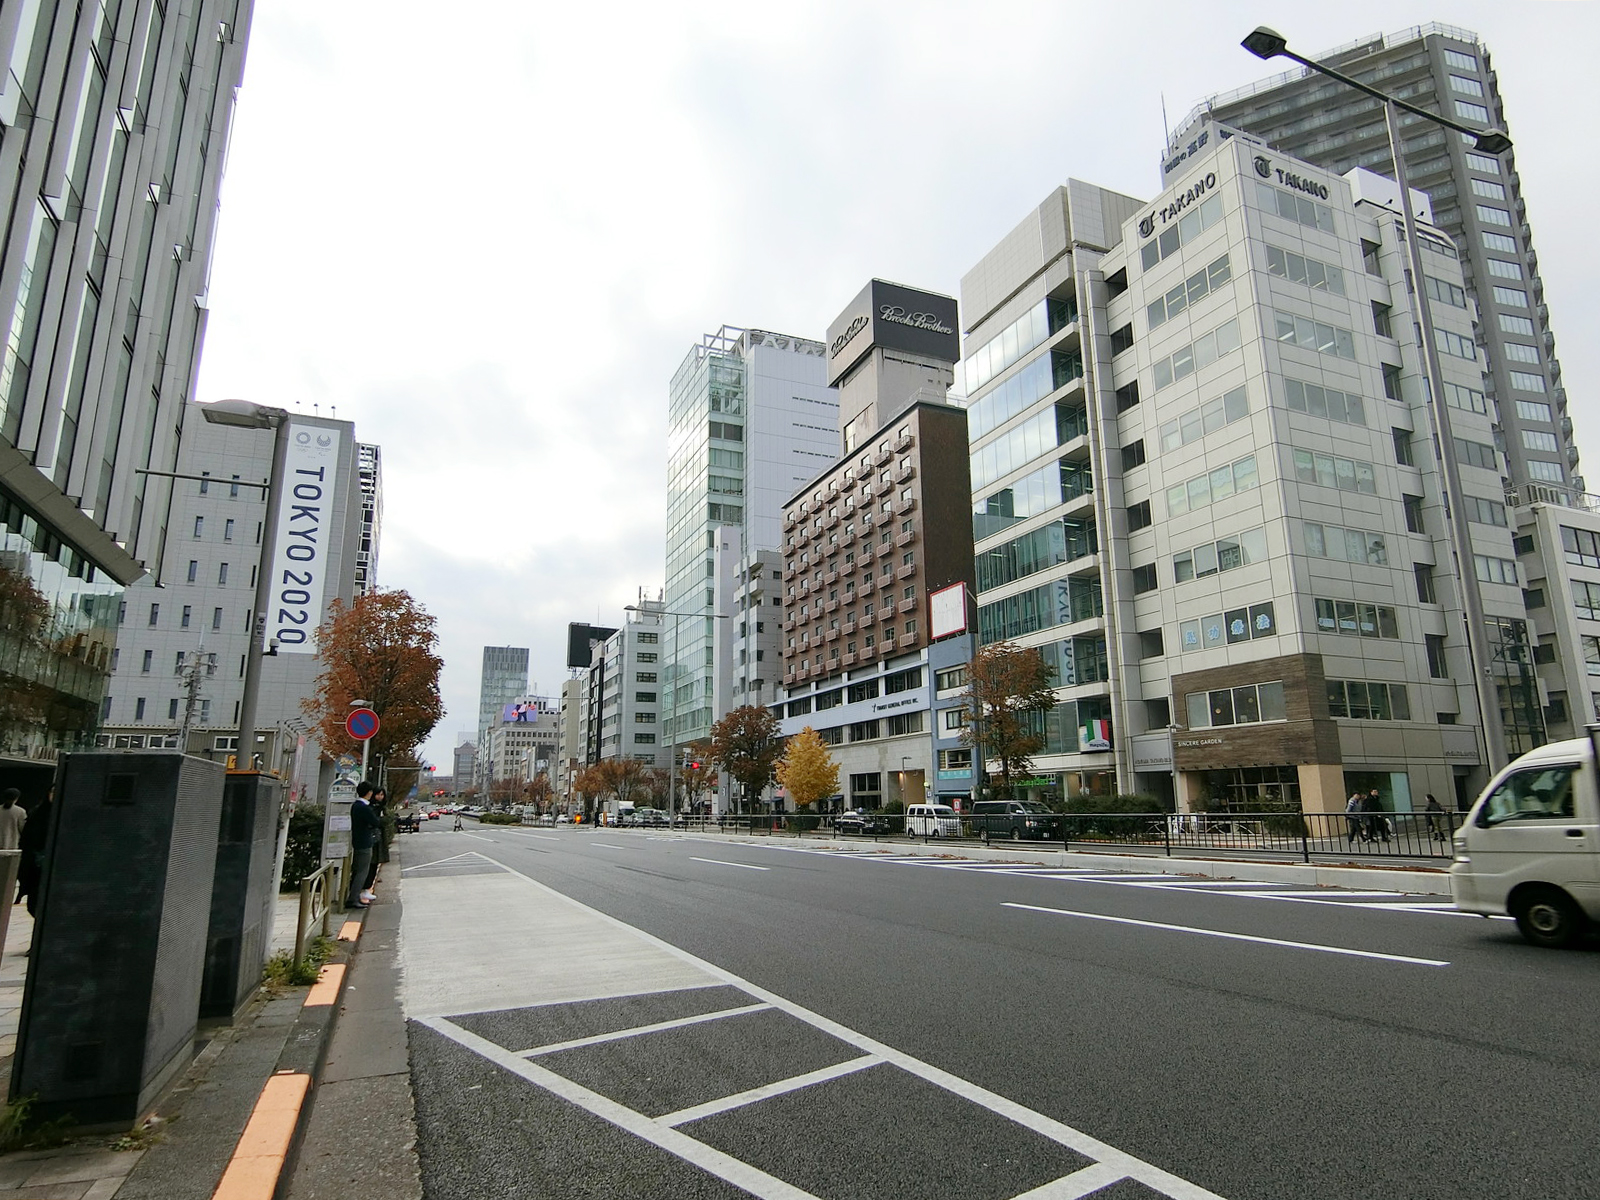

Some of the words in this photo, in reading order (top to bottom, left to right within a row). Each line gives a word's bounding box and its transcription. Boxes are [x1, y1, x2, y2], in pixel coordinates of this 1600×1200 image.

[1159, 172, 1216, 224] TAKANO
[1276, 168, 1329, 200] TAKANO
[880, 305, 914, 326] Brooks
[913, 312, 953, 335] Brothers
[286, 466, 325, 561] TOKYO
[276, 569, 313, 644] 2020
